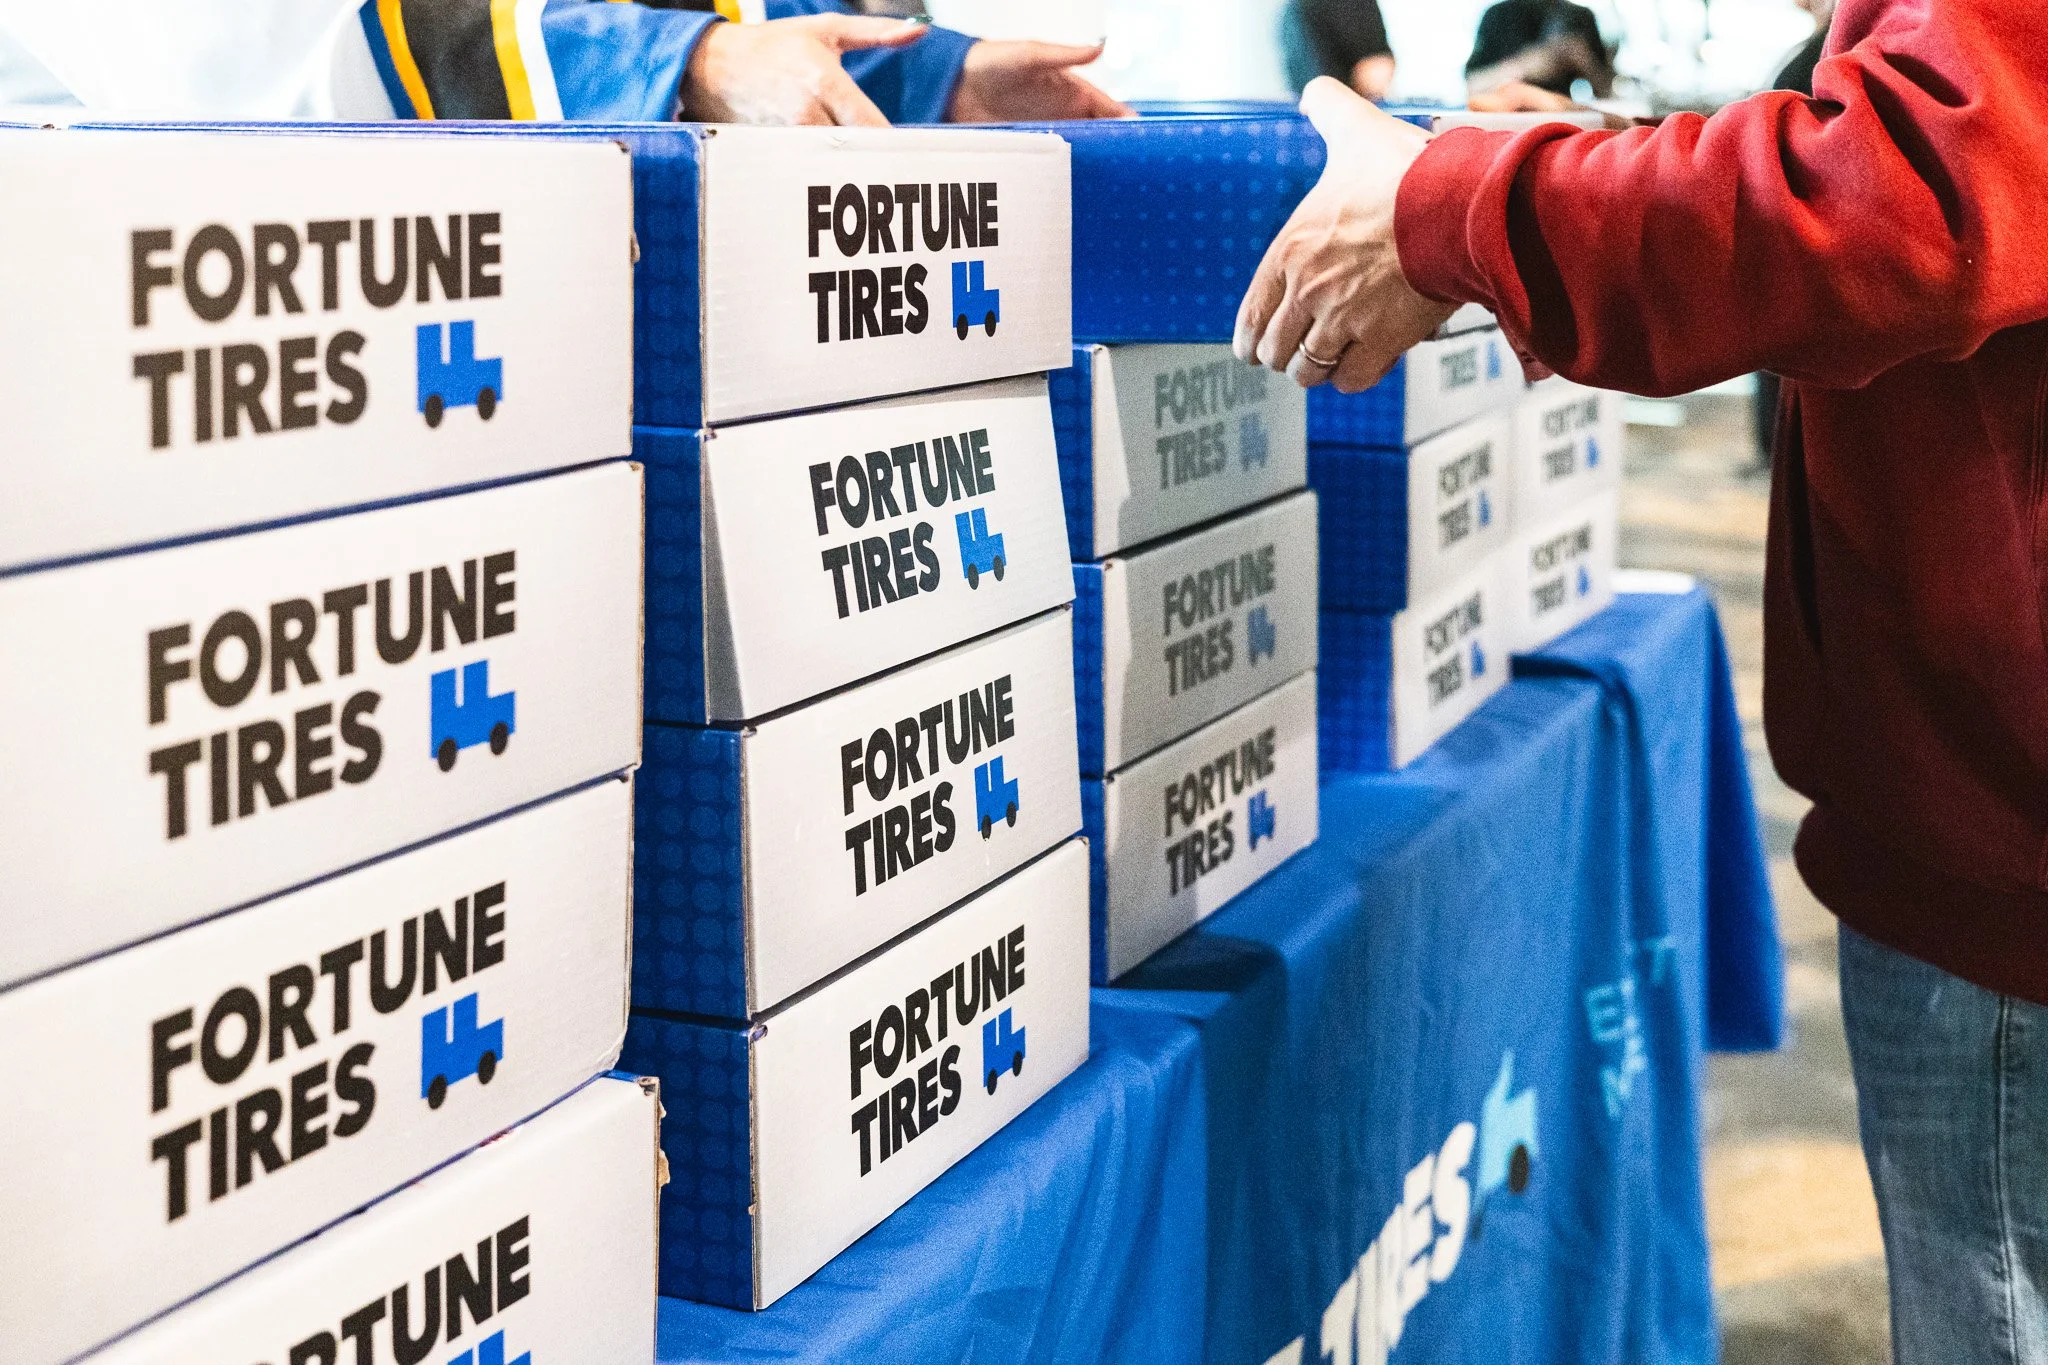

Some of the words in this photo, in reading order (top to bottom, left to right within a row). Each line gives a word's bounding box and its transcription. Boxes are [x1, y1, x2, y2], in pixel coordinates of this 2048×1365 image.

[128, 211, 502, 329] FORTUNE
[807, 182, 998, 257] FORTUNE
[808, 263, 929, 343] TIRES
[132, 329, 369, 452] TIRES
[808, 428, 996, 536] FORTUNE
[1156, 421, 1227, 490] TIRES
[821, 521, 940, 619] TIRES
[1163, 542, 1276, 636] FORTUNE
[147, 550, 516, 727] FORTUNE
[1164, 618, 1235, 697] TIRES
[148, 690, 383, 840] TIRES
[840, 673, 1015, 816] FORTUNE
[1164, 725, 1276, 838] FORTUNE
[845, 781, 956, 897] TIRES
[1165, 809, 1235, 898] TIRES
[150, 881, 507, 1116] FORTUNE
[849, 924, 1025, 1100] FORTUNE
[151, 1042, 378, 1225] TIRES
[851, 1044, 962, 1178] TIRES
